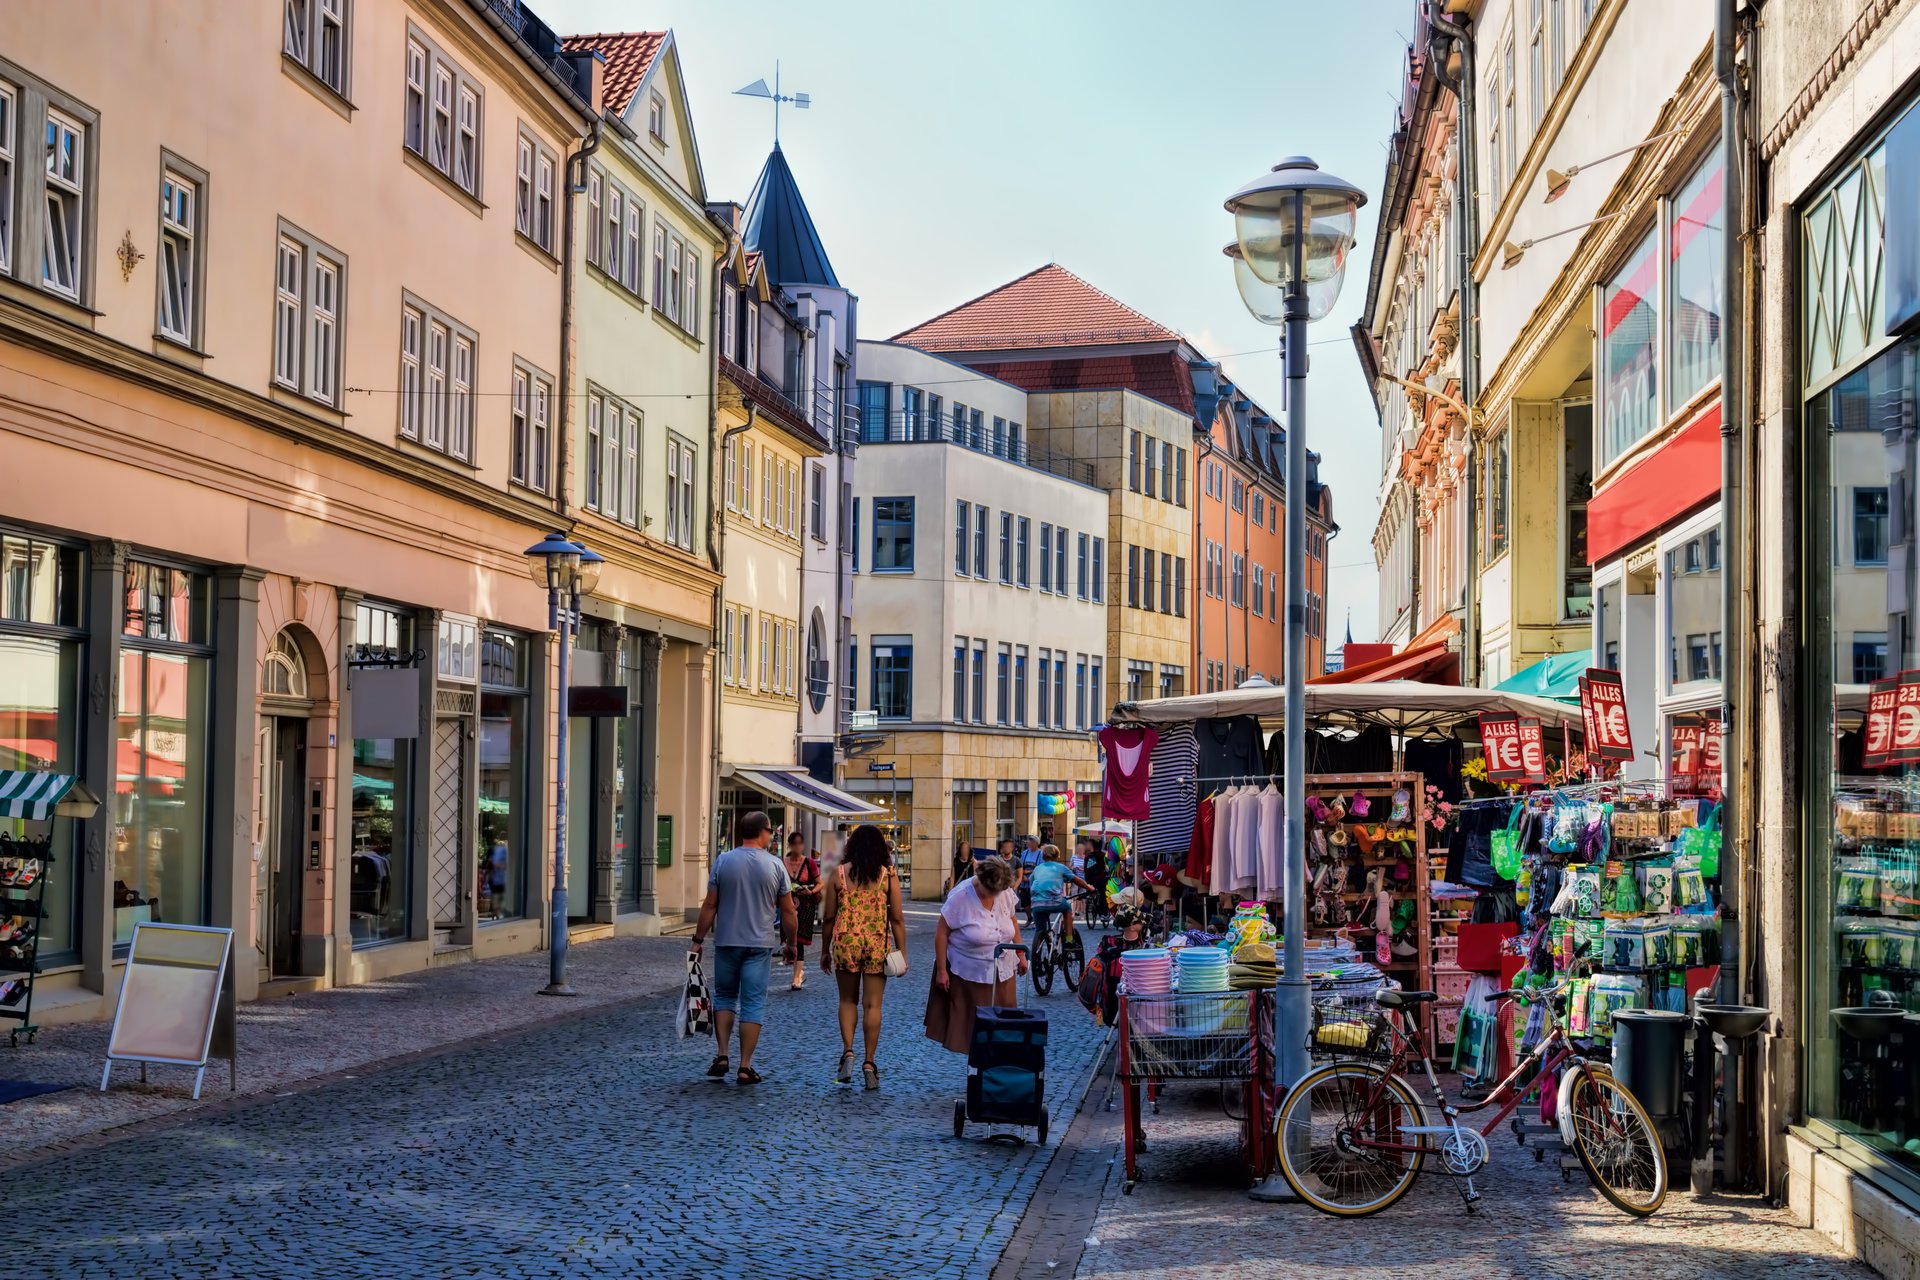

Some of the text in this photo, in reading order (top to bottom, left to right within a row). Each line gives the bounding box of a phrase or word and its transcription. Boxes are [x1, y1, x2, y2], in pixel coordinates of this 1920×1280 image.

[1592, 684, 1621, 702] ALLES
[1485, 723, 1517, 736] ALLES
[1520, 728, 1539, 741] LES
[1594, 703, 1628, 745] 1€
[1485, 737, 1521, 770] 1€
[1860, 844, 1918, 885] COECTION
